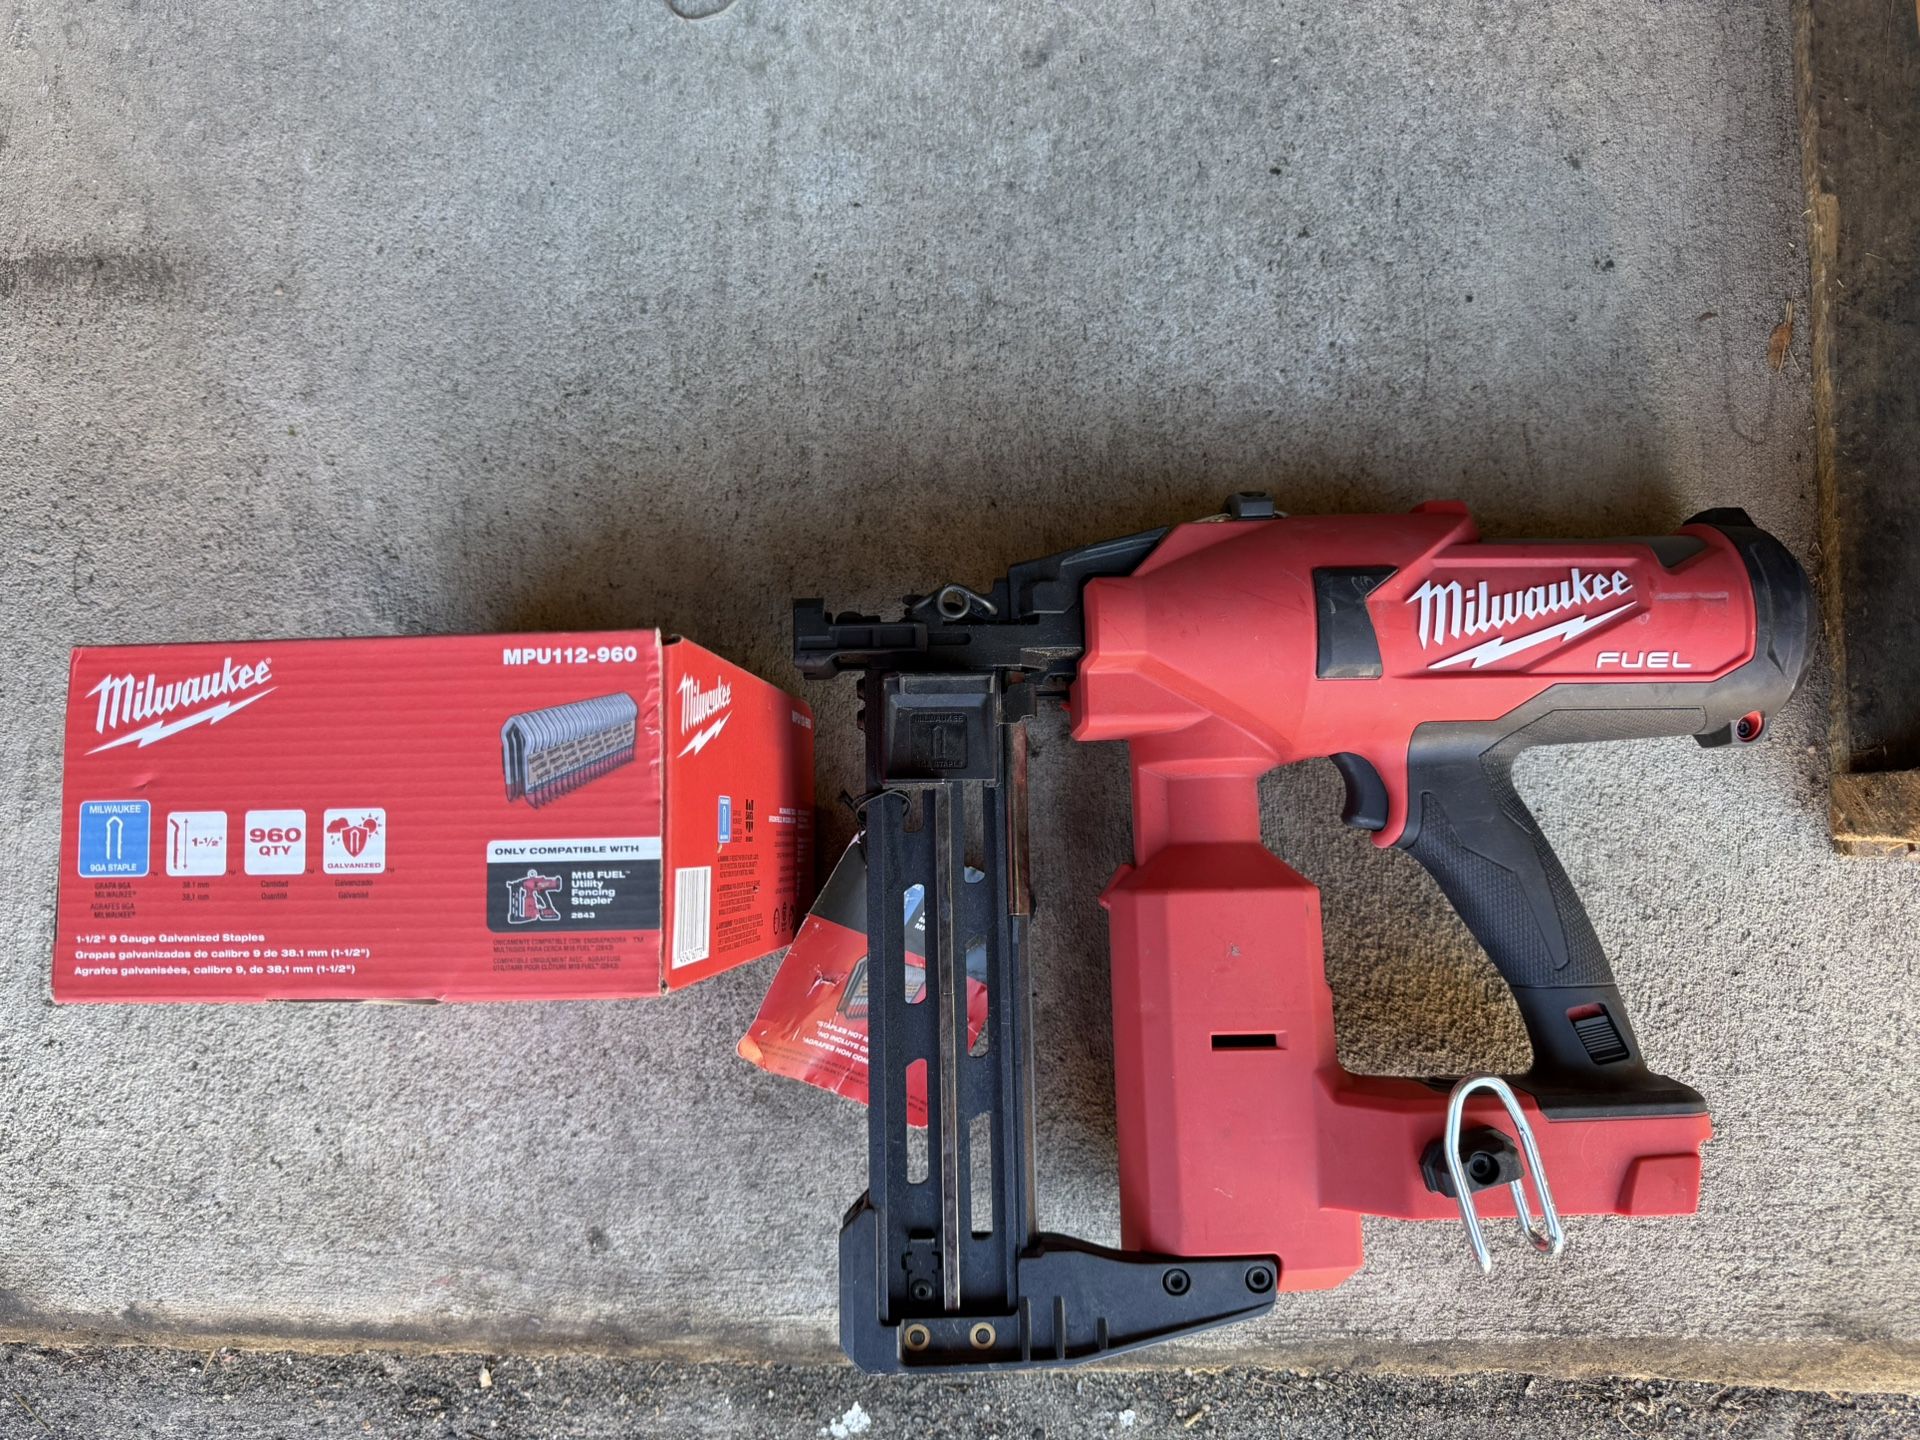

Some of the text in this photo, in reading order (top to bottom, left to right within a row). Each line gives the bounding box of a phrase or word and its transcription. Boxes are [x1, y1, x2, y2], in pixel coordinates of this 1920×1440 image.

[1405, 568, 1634, 650] Milwaukee
[502, 646, 638, 665] MPU112-960
[1596, 652, 1692, 669] FUEL
[676, 672, 733, 737] Milwaukee
[89, 805, 141, 814] MILWAUKEE
[249, 827, 302, 844] 960
[259, 845, 292, 857] QTY
[494, 845, 640, 856] ONLY COMPATIBLE WITH
[89, 863, 137, 873] 9GA STAPLE
[327, 862, 382, 870] GALVANIZED
[571, 871, 595, 879] M18
[571, 879, 604, 889] Utility
[571, 887, 615, 897] Fencing
[571, 896, 613, 906] Stapler
[109, 935, 117, 943] 9
[119, 934, 156, 945] Gauge
[158, 933, 220, 943] Galvanized
[222, 933, 266, 943] Staples
[75, 950, 116, 961] Grapas
[118, 949, 192, 961] galvanizadas
[193, 950, 209, 959] de
[211, 949, 250, 959] calibre
[252, 949, 261, 958] 9
[263, 948, 279, 958] de
[280, 948, 305, 958] 38.1
[306, 950, 329, 958] mm
[74, 966, 118, 977] Agrafes
[120, 966, 191, 977] galvanisées,
[193, 965, 233, 975] calibre
[235, 965, 247, 976] 9,
[249, 965, 264, 974] de
[266, 964, 290, 976] 38,1
[292, 966, 314, 974] mm
